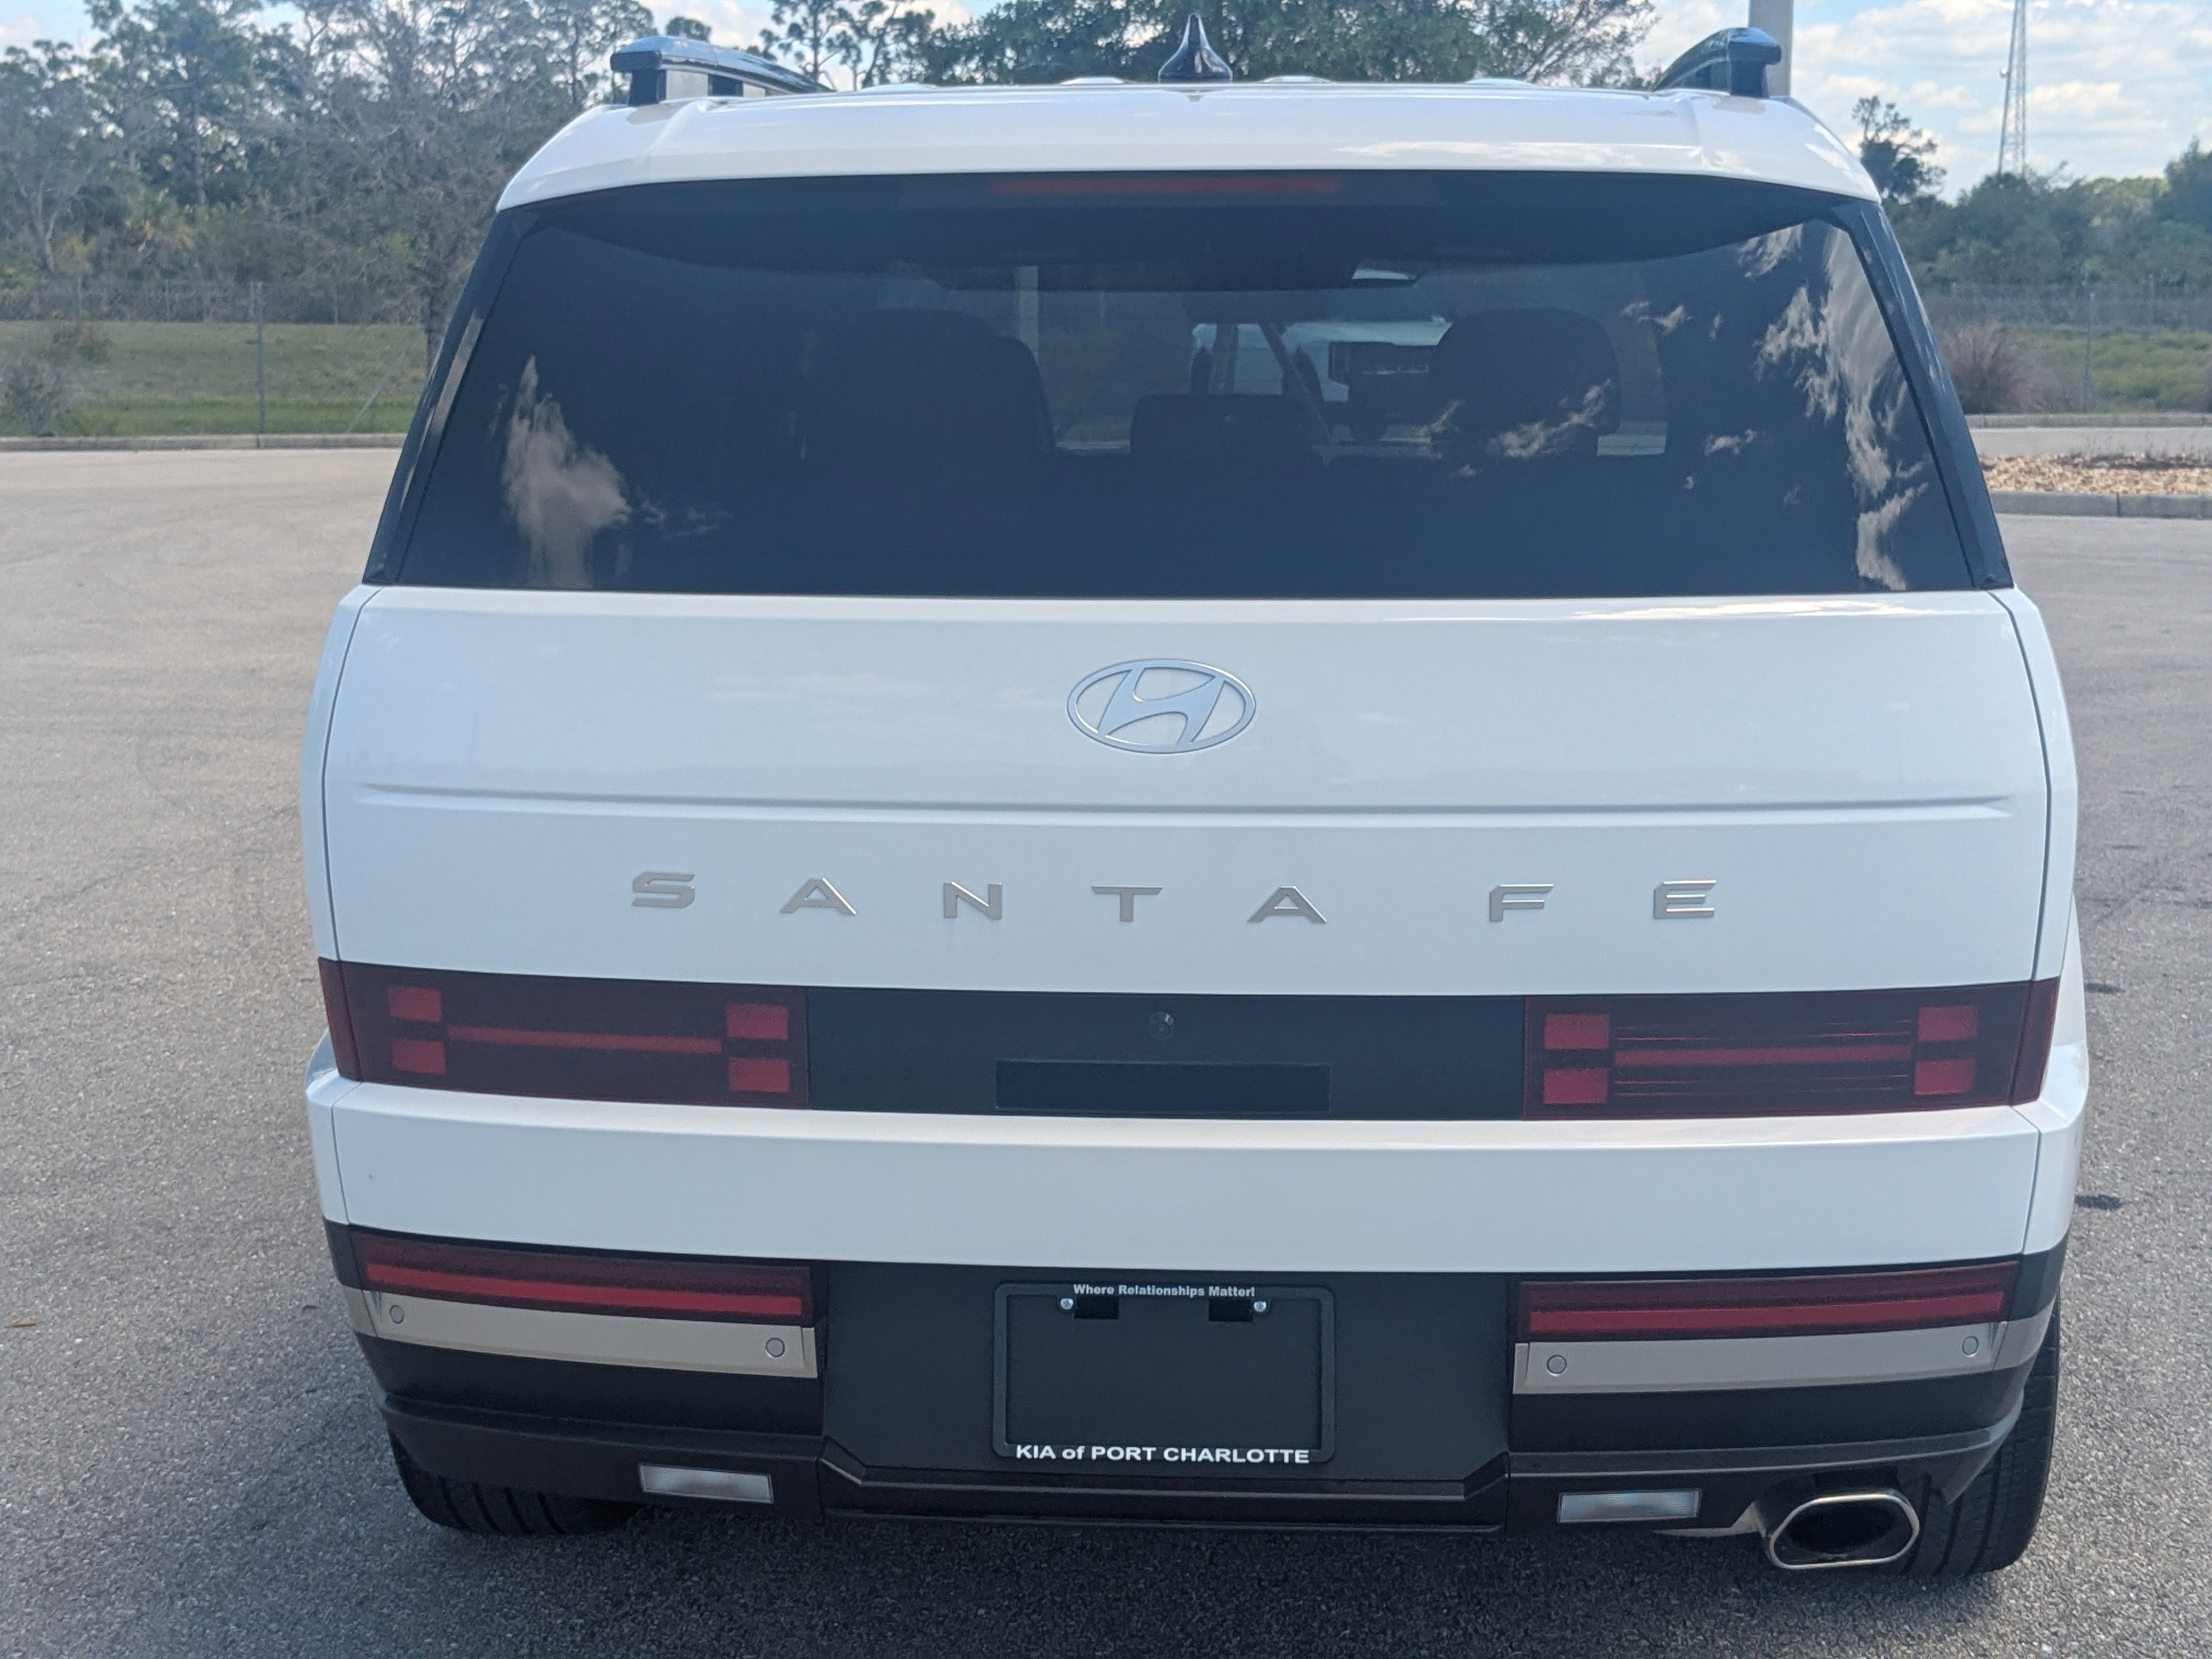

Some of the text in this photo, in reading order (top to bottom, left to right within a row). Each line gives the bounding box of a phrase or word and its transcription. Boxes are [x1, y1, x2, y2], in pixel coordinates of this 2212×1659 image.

[632, 871, 1718, 924] SANTA FE
[1073, 1284, 1256, 1298] Where Relationships Matter!
[1016, 1444, 1310, 1464] KIA of PORT CHARLOTTE
